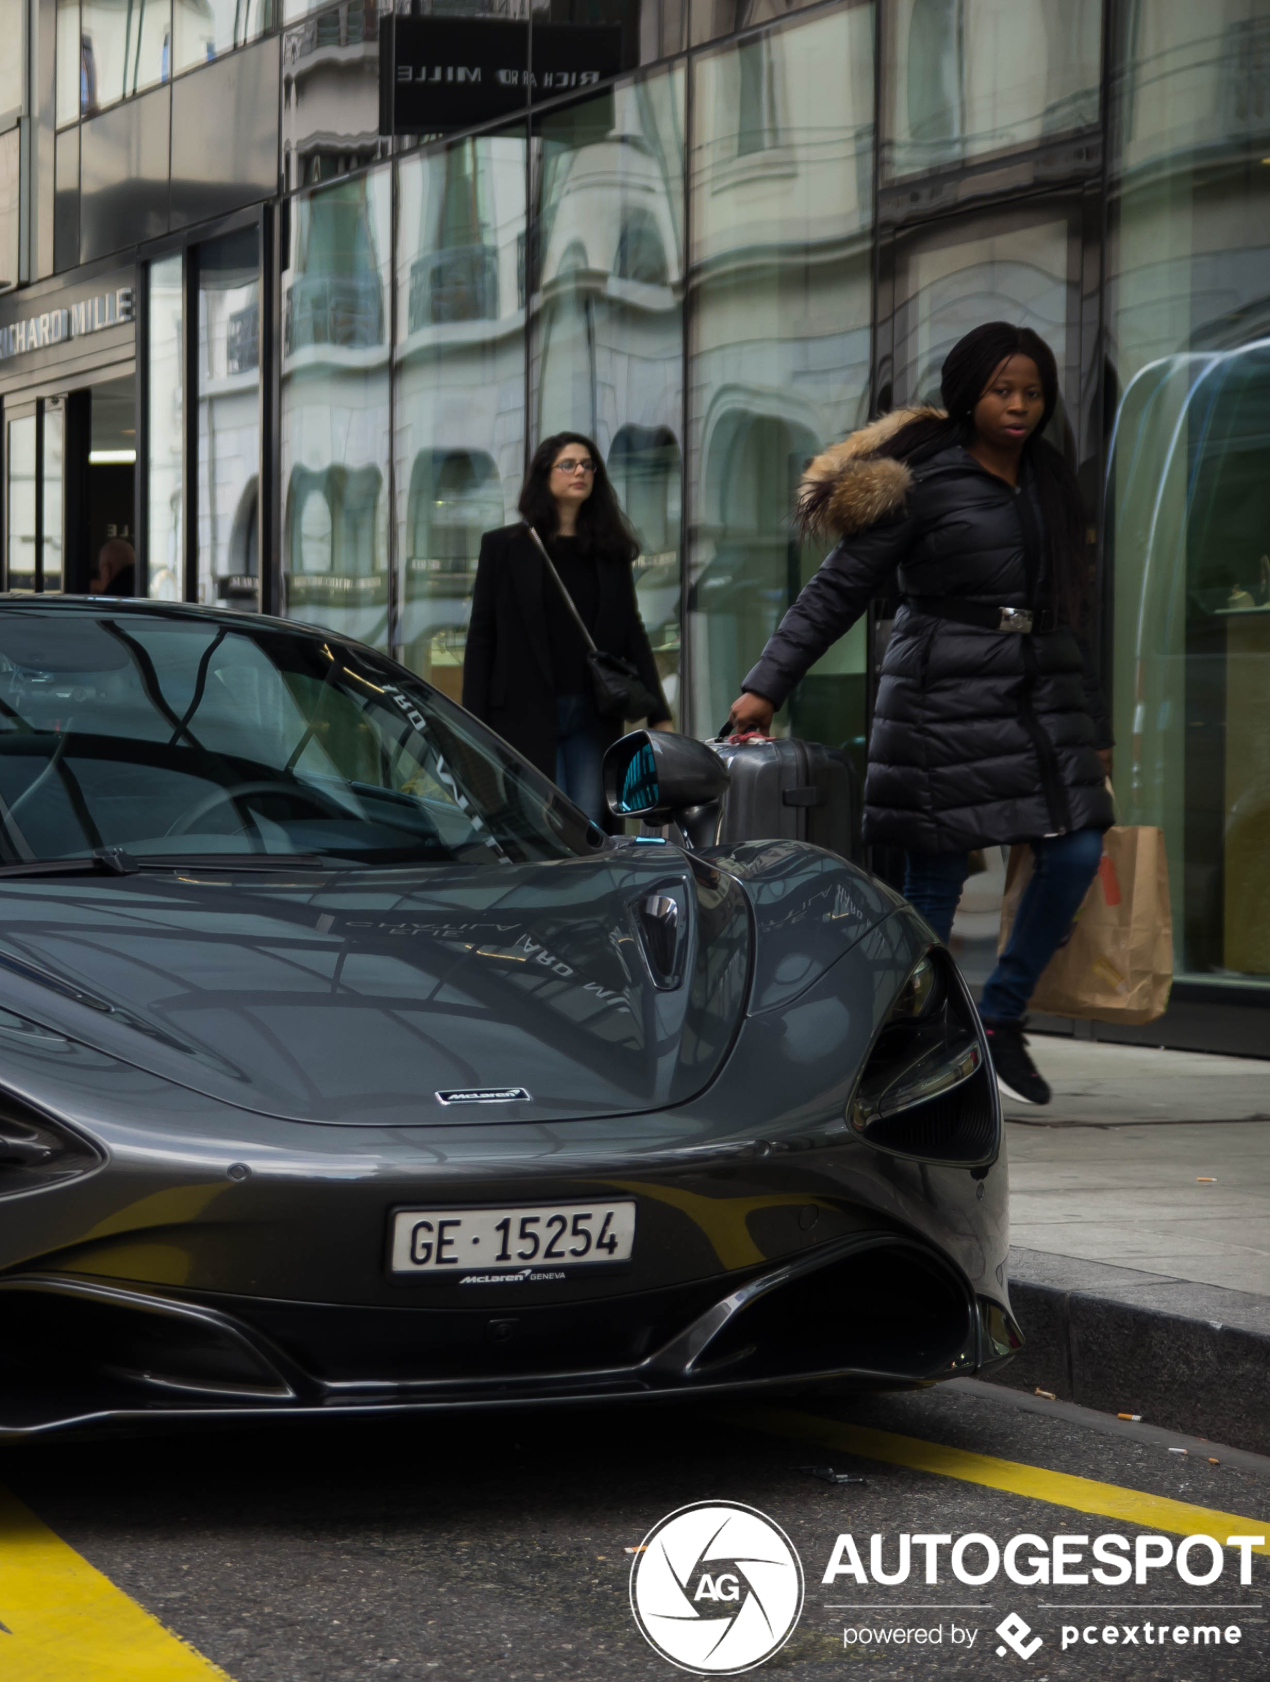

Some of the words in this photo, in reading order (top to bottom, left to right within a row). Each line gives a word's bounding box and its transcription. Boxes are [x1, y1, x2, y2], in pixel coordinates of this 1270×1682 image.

[71, 287, 132, 337] MILLE
[447, 1090, 520, 1100] McLaren
[409, 1219, 462, 1265] GE
[494, 1211, 619, 1261] 15254
[459, 1271, 527, 1284] McLaren
[530, 1271, 566, 1281] GENEVA
